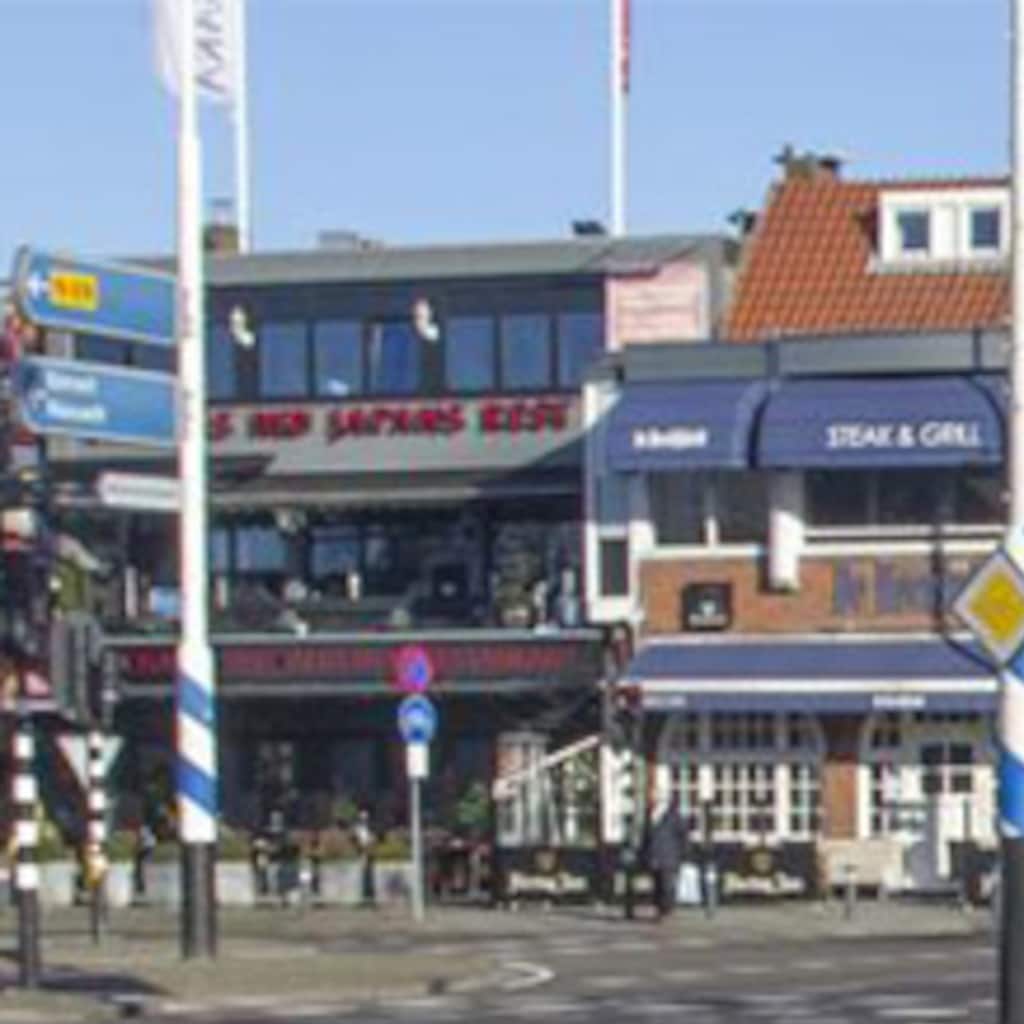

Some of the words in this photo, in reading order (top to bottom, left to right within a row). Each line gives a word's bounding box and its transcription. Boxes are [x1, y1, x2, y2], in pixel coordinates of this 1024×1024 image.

[826, 423, 894, 450] STEAK
[897, 424, 915, 449] &
[918, 420, 982, 449] GRILL
